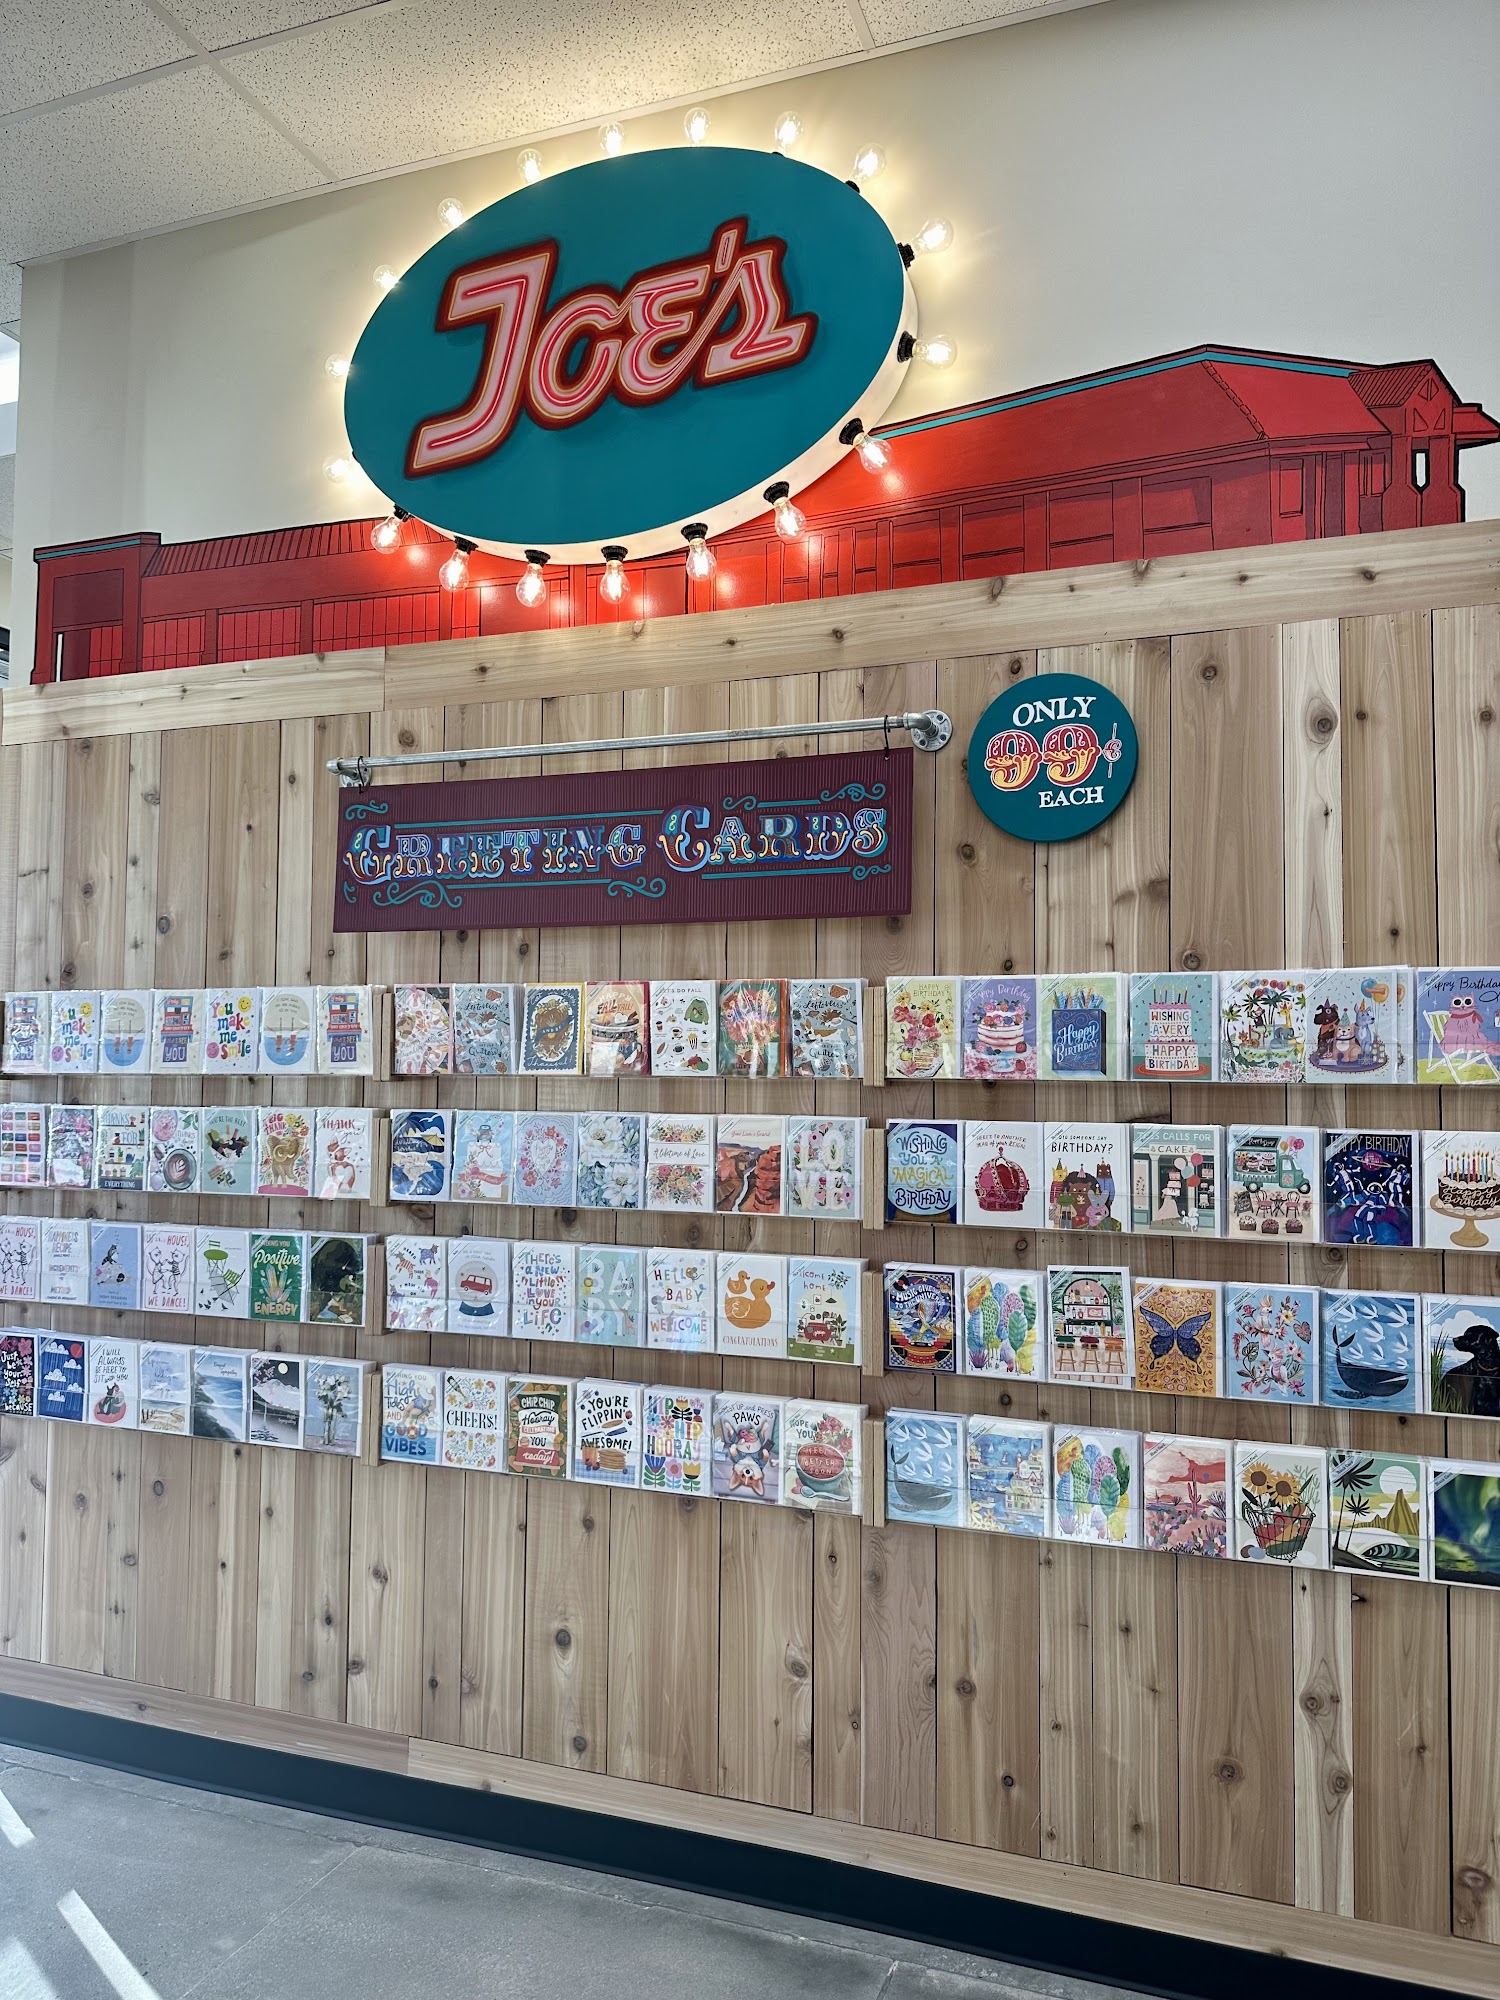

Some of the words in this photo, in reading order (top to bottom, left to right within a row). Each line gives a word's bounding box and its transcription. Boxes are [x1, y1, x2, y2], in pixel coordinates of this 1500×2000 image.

[1012, 696, 1097, 727] ONLY
[1038, 786, 1104, 808] EACH
[342, 823, 647, 885] GREETING
[658, 805, 889, 873] CARDS
[1047, 980, 1060, 992] Birthday
[1137, 979, 1151, 991] Birthday
[1458, 976, 1500, 990] Birthda
[598, 991, 632, 1002] HAPPY
[997, 983, 1032, 1003] Birthday
[212, 1003, 233, 1018] You
[597, 999, 617, 1014] FALL
[217, 1012, 250, 1031] make
[1151, 1010, 1190, 1022] WISHING
[62, 1018, 92, 1036] make
[1056, 1020, 1100, 1045] Happy
[1153, 1024, 1159, 1035] A
[1162, 1024, 1190, 1035] VERY
[64, 1034, 80, 1047] me
[220, 1030, 237, 1044] me
[1152, 1044, 1190, 1056] HAPPY
[1149, 1059, 1194, 1070] BIRTHDAY
[1001, 1134, 1026, 1142] ANOTHER
[1162, 1131, 1190, 1141] CALLS
[1193, 1132, 1211, 1142] FOR
[1432, 1137, 1447, 1150] Birthday
[1051, 1142, 1114, 1155] BIRTHDAY?
[1157, 1145, 1189, 1154] CAKE
[1365, 1135, 1412, 1158] BIRTHDAY
[684, 1149, 690, 1157] of
[691, 1149, 705, 1159] Love
[1442, 1185, 1499, 1199] Happy
[1442, 1195, 1500, 1210] Birthday
[254, 1247, 300, 1271] Positive
[11, 1286, 33, 1296] DANCE!
[803, 1281, 826, 1291] home
[666, 1287, 704, 1302] BABY
[896, 1289, 918, 1301] MUSIC
[148, 1296, 160, 1306] WE
[162, 1297, 187, 1308] DANCE!
[254, 1301, 299, 1317] ENERGY
[722, 1336, 778, 1347] CONGRATULATIONS
[1, 1351, 19, 1363] Just
[98, 1356, 125, 1366] ALWAYS
[7, 1361, 17, 1369] be
[95, 1366, 102, 1374] BE
[103, 1366, 118, 1374] HERE
[94, 1374, 104, 1384] SIT
[117, 1373, 129, 1382] YOU
[386, 1379, 417, 1404] High
[588, 1395, 629, 1412] YOU'RE
[386, 1411, 401, 1421] AND
[522, 1410, 555, 1426] Hooray
[581, 1408, 626, 1430] FLIPPIN'
[732, 1412, 761, 1426] PAWS
[745, 1404, 756, 1412] and
[757, 1405, 774, 1420] PRESS
[446, 1409, 498, 1431] CHEERS!
[385, 1421, 428, 1440] GOOD
[674, 1420, 703, 1441] HIP
[795, 1429, 813, 1439] YOU
[385, 1437, 427, 1456] VIBES
[530, 1436, 546, 1447] YOU
[580, 1436, 632, 1454] AWESOME!
[646, 1434, 700, 1460] HOORAY
[522, 1450, 554, 1464] today!
[808, 1447, 827, 1455] FEEL
